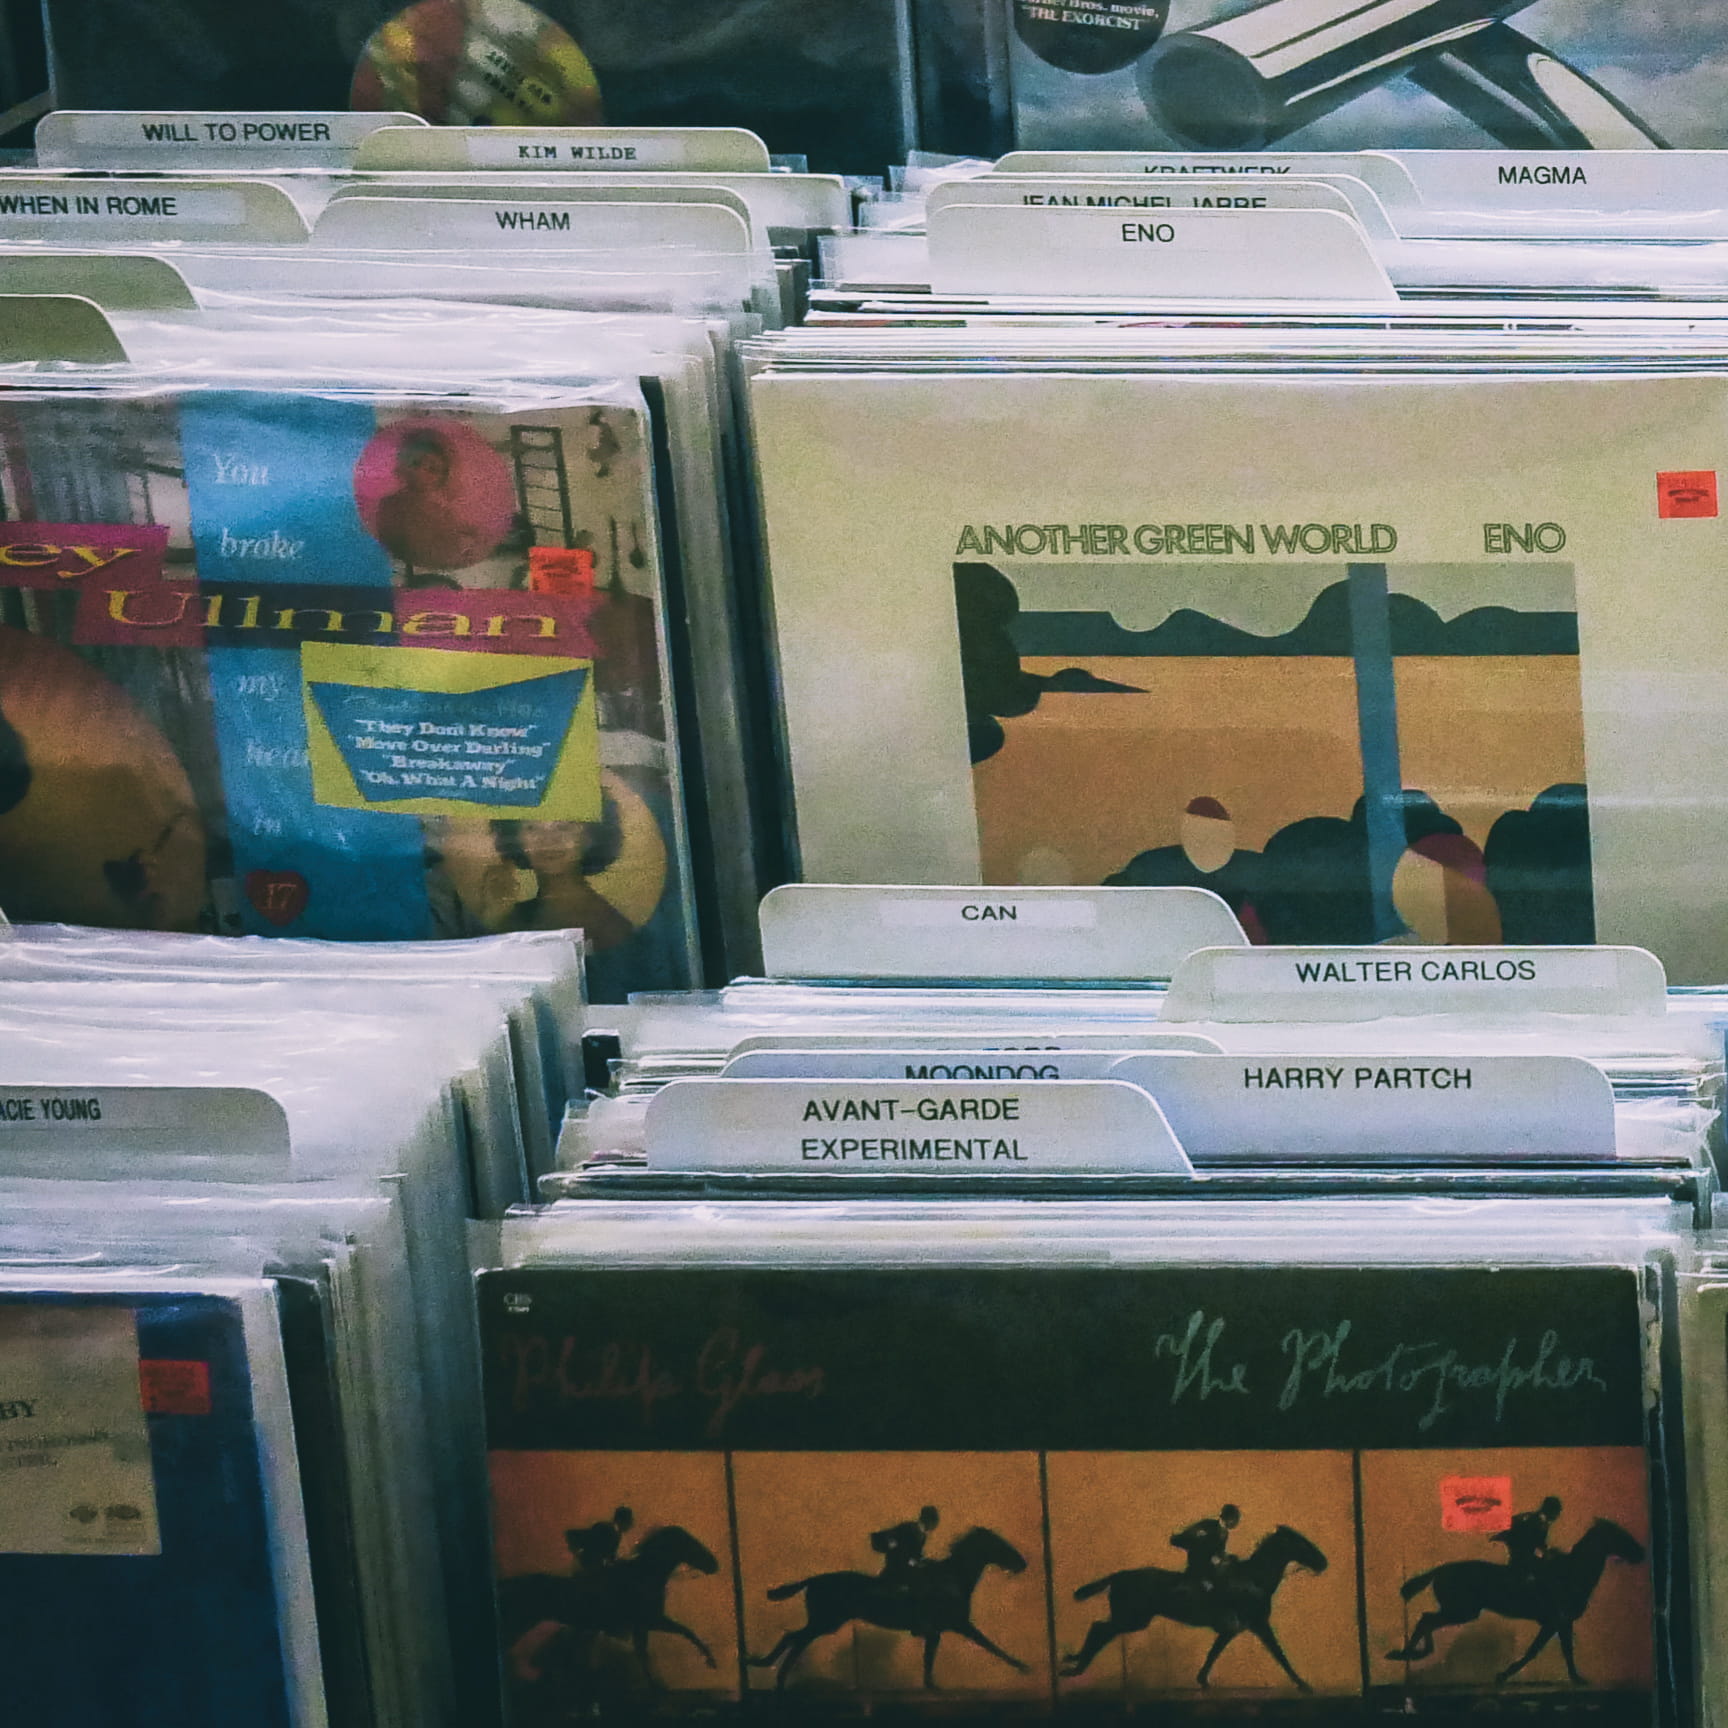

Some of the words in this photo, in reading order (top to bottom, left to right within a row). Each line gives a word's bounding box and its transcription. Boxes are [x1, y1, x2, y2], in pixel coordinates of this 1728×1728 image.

[141, 123, 199, 142] WILL
[203, 122, 237, 142] TO
[242, 122, 331, 142] POWER
[518, 145, 558, 159] KIM
[570, 146, 637, 161] WILDE
[1498, 165, 1587, 185] MAGMA
[0, 194, 69, 215] WHEN
[75, 196, 100, 215] IN
[105, 196, 178, 216] ROME
[494, 211, 570, 231] WHAM
[1120, 222, 1177, 244] ENO
[211, 454, 270, 487] You
[219, 528, 306, 562] broke
[955, 523, 1129, 557] ANOTHER
[1132, 523, 1256, 557] GREEN
[1260, 523, 1397, 557] WORLD
[1483, 522, 1567, 556] ENO
[103, 587, 560, 641] Ullman
[961, 905, 1017, 921] CAN
[1295, 961, 1412, 984] WALTER
[1421, 959, 1536, 982] CARLOS
[1244, 1067, 1345, 1090] HARRY
[1354, 1067, 1472, 1090] PARTCH
[40, 1099, 102, 1121] YOUNG
[802, 1098, 1021, 1122] AVANT-GARDE
[801, 1138, 1029, 1161] EXPERIMENTAL
[1155, 1310, 1254, 1407] The
[1276, 1315, 1608, 1432] Photographer
